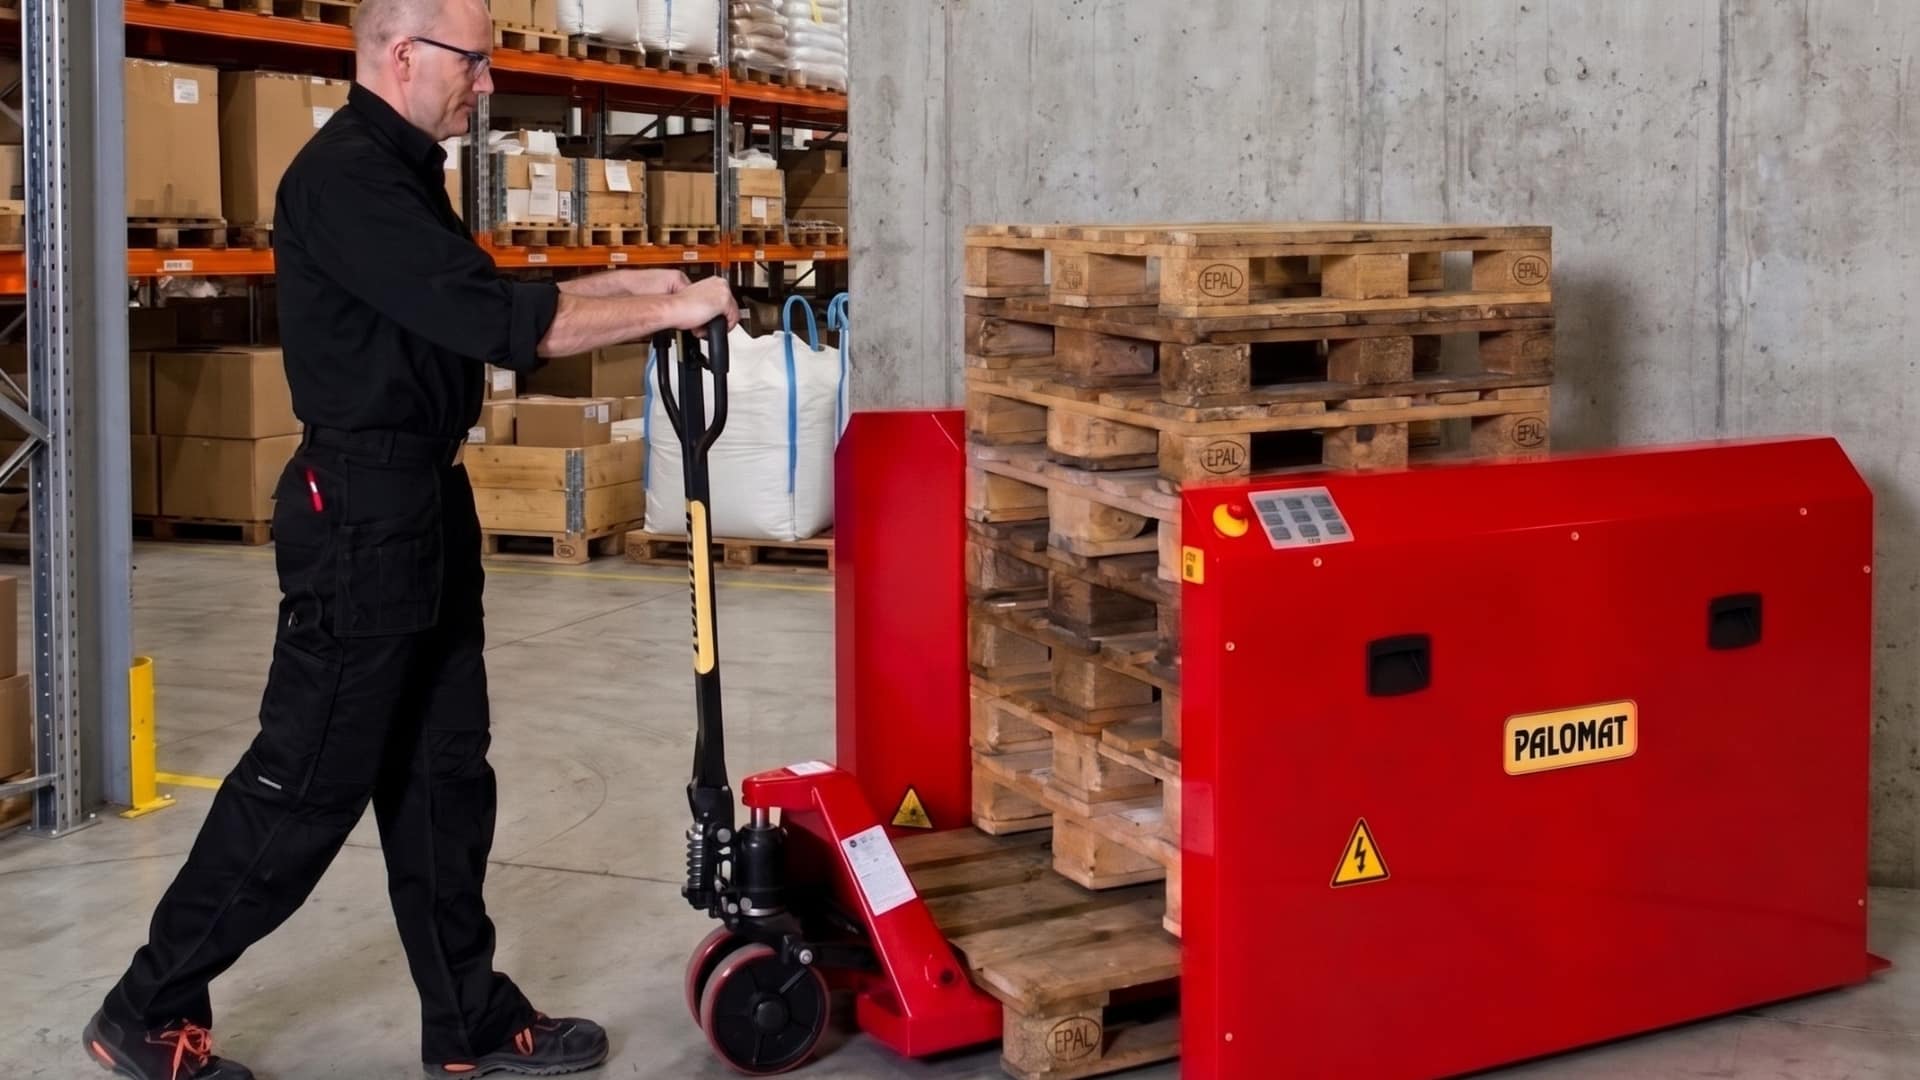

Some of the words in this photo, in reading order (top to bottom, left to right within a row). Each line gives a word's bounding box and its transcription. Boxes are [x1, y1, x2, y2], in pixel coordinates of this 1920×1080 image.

[1518, 262, 1543, 279] EPAL
[1204, 271, 1237, 290] EPAL
[1517, 423, 1542, 441] EPAL
[1207, 447, 1239, 467] EPAL
[1515, 715, 1628, 762] PALOMAT
[1055, 1024, 1094, 1053] EPAL
